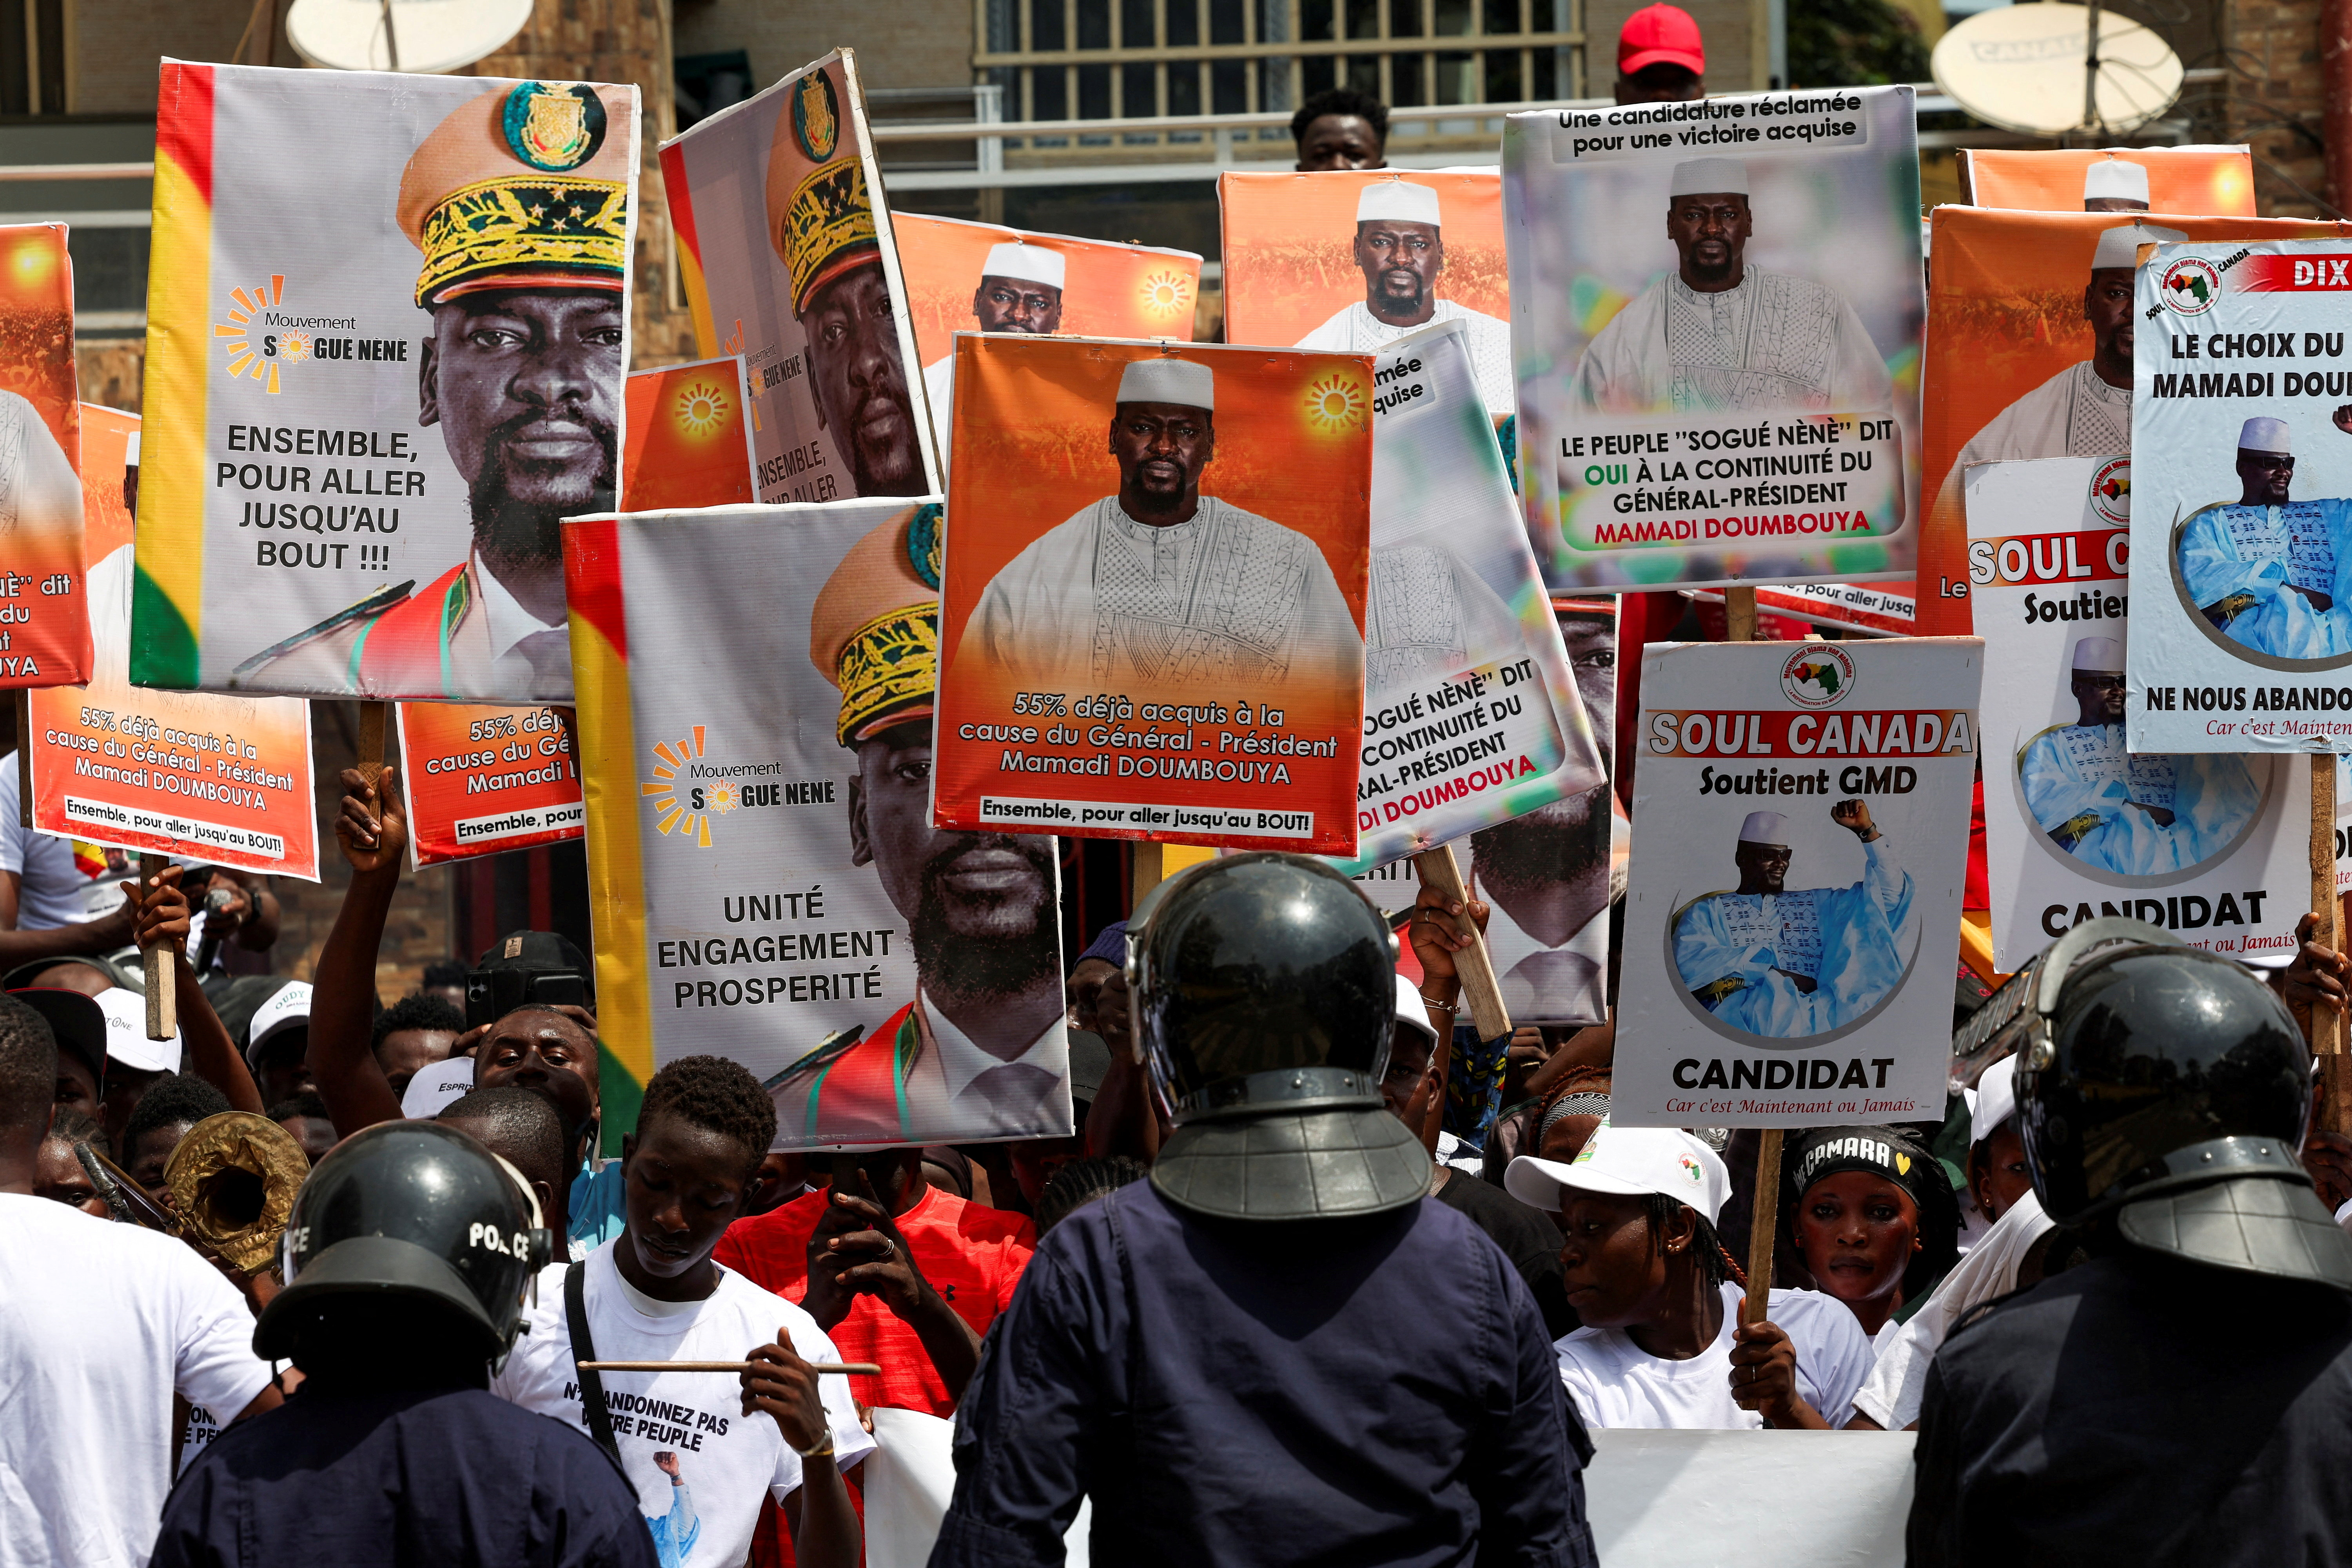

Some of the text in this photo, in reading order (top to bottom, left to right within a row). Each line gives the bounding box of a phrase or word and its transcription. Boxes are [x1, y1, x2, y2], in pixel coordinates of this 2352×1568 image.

[1559, 92, 1862, 129] Une candidature réclamée
[1573, 120, 1857, 158] pour une victoire acquise
[2146, 248, 2250, 320] SOUL CANADA
[2294, 260, 2350, 286] DIX
[265, 311, 357, 331] Mouvement
[2170, 302, 2195, 314] REFONDATION
[357, 336, 408, 362] NÈNÈ
[2172, 332, 2344, 359] LE CHOIX DU
[779, 352, 802, 382] NÈNÈ
[2152, 372, 2352, 398] MAMADI DOU
[227, 424, 418, 463] ENSEMBLE,
[1561, 436, 1585, 457] LE
[1591, 432, 1669, 456] PEUPLE
[1859, 419, 1894, 441] DIT
[216, 463, 427, 497] POUR ALLER
[1584, 447, 1873, 486] OUI À LA CONTINUITÉ DU
[1613, 481, 1848, 514] GÉNÉRAL-PRÉSIDENT
[1594, 510, 1871, 544] MAMADI DOUMBOUYA
[256, 540, 390, 571] BOUT !!!
[1968, 535, 2091, 586] SOUL
[40, 574, 71, 595] dit
[1804, 585, 1841, 599] pour
[1845, 591, 1878, 607] aller
[1940, 575, 1968, 599] Le
[0, 603, 30, 624] du
[1501, 659, 1534, 687] DIT
[1784, 649, 1807, 679] Mouvement
[1013, 692, 1284, 731] 55% déjà acquis à la
[1791, 693, 1821, 706] REFONDATION
[1828, 689, 1846, 703] MARCHE
[2147, 687, 2176, 711] NE
[2183, 687, 2247, 711] NOUS
[80, 707, 257, 760] 55% déjà acquis à la
[469, 715, 517, 742] 55%
[958, 722, 1038, 744] cause
[1046, 721, 1079, 746] du
[1087, 722, 1193, 751] Général
[1218, 728, 1338, 758] Président
[1361, 694, 1523, 767] CONTINUITÉ DU
[1649, 712, 1974, 755] SOUL CANADA
[2206, 719, 2237, 735] Car
[2241, 717, 2276, 735] c'est
[46, 729, 99, 753] cause
[104, 737, 126, 758] du
[131, 743, 200, 773] Général
[217, 759, 293, 791] Président
[425, 750, 496, 775] cause
[502, 741, 531, 762] du
[690, 761, 782, 780] Mouvement
[1000, 750, 1291, 785] Mamadi DOUMBOUYA
[74, 757, 267, 811] Mamadi DOUMBOUYA
[467, 760, 563, 795] Mamadi
[785, 779, 836, 806] NÈNÈ
[1383, 755, 1537, 823] DOUMBOUYA
[1699, 765, 1918, 796] Soutient GMD
[67, 799, 131, 825] Ensemble,
[134, 815, 162, 829] pour
[165, 820, 191, 835] aller
[248, 833, 281, 852] BOUT!
[458, 808, 583, 838] Ensemble, pour
[982, 799, 1076, 821] Ensemble,
[1082, 807, 1124, 826] pour
[1129, 806, 1170, 824] aller
[1257, 813, 1310, 831] BOUT!
[723, 884, 825, 924] UNITÉ
[657, 929, 895, 970] ENGAGEMENT
[2215, 939, 2235, 953] ou
[2238, 931, 2295, 953] Jamais
[674, 964, 883, 1009] PROSPERITÉ
[1672, 1057, 1895, 1090] CANDIDAT
[1666, 1096, 1915, 1115] Car c'est Maintenant ou Jamais
[1806, 1137, 1890, 1176] CAMARA
[582, 1408, 704, 1453] VTRE PEUPLE
[696, 1412, 729, 1436] PAS
